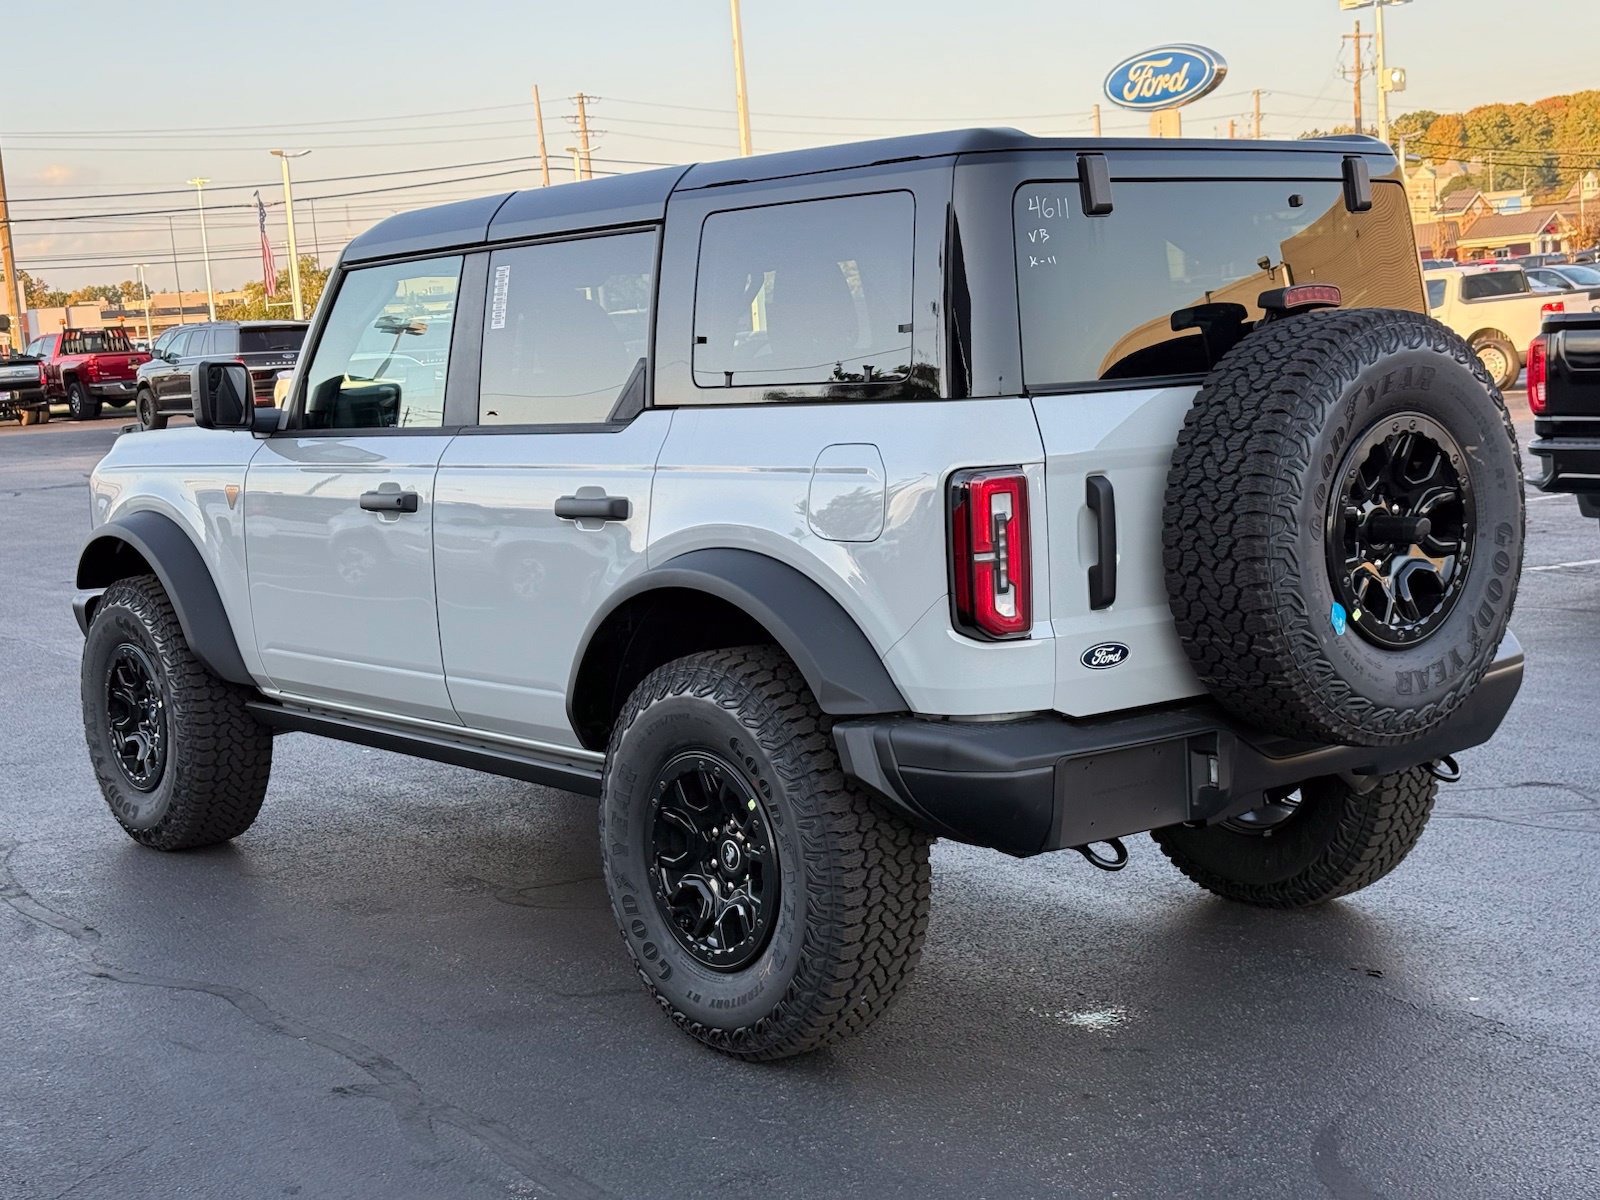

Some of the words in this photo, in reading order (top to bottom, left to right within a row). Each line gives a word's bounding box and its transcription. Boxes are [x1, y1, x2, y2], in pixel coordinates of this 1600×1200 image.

[1122, 57, 1190, 101] Ford
[1028, 195, 1069, 219] 4611
[1028, 228, 1050, 244] VB
[1091, 646, 1122, 665] Ford
